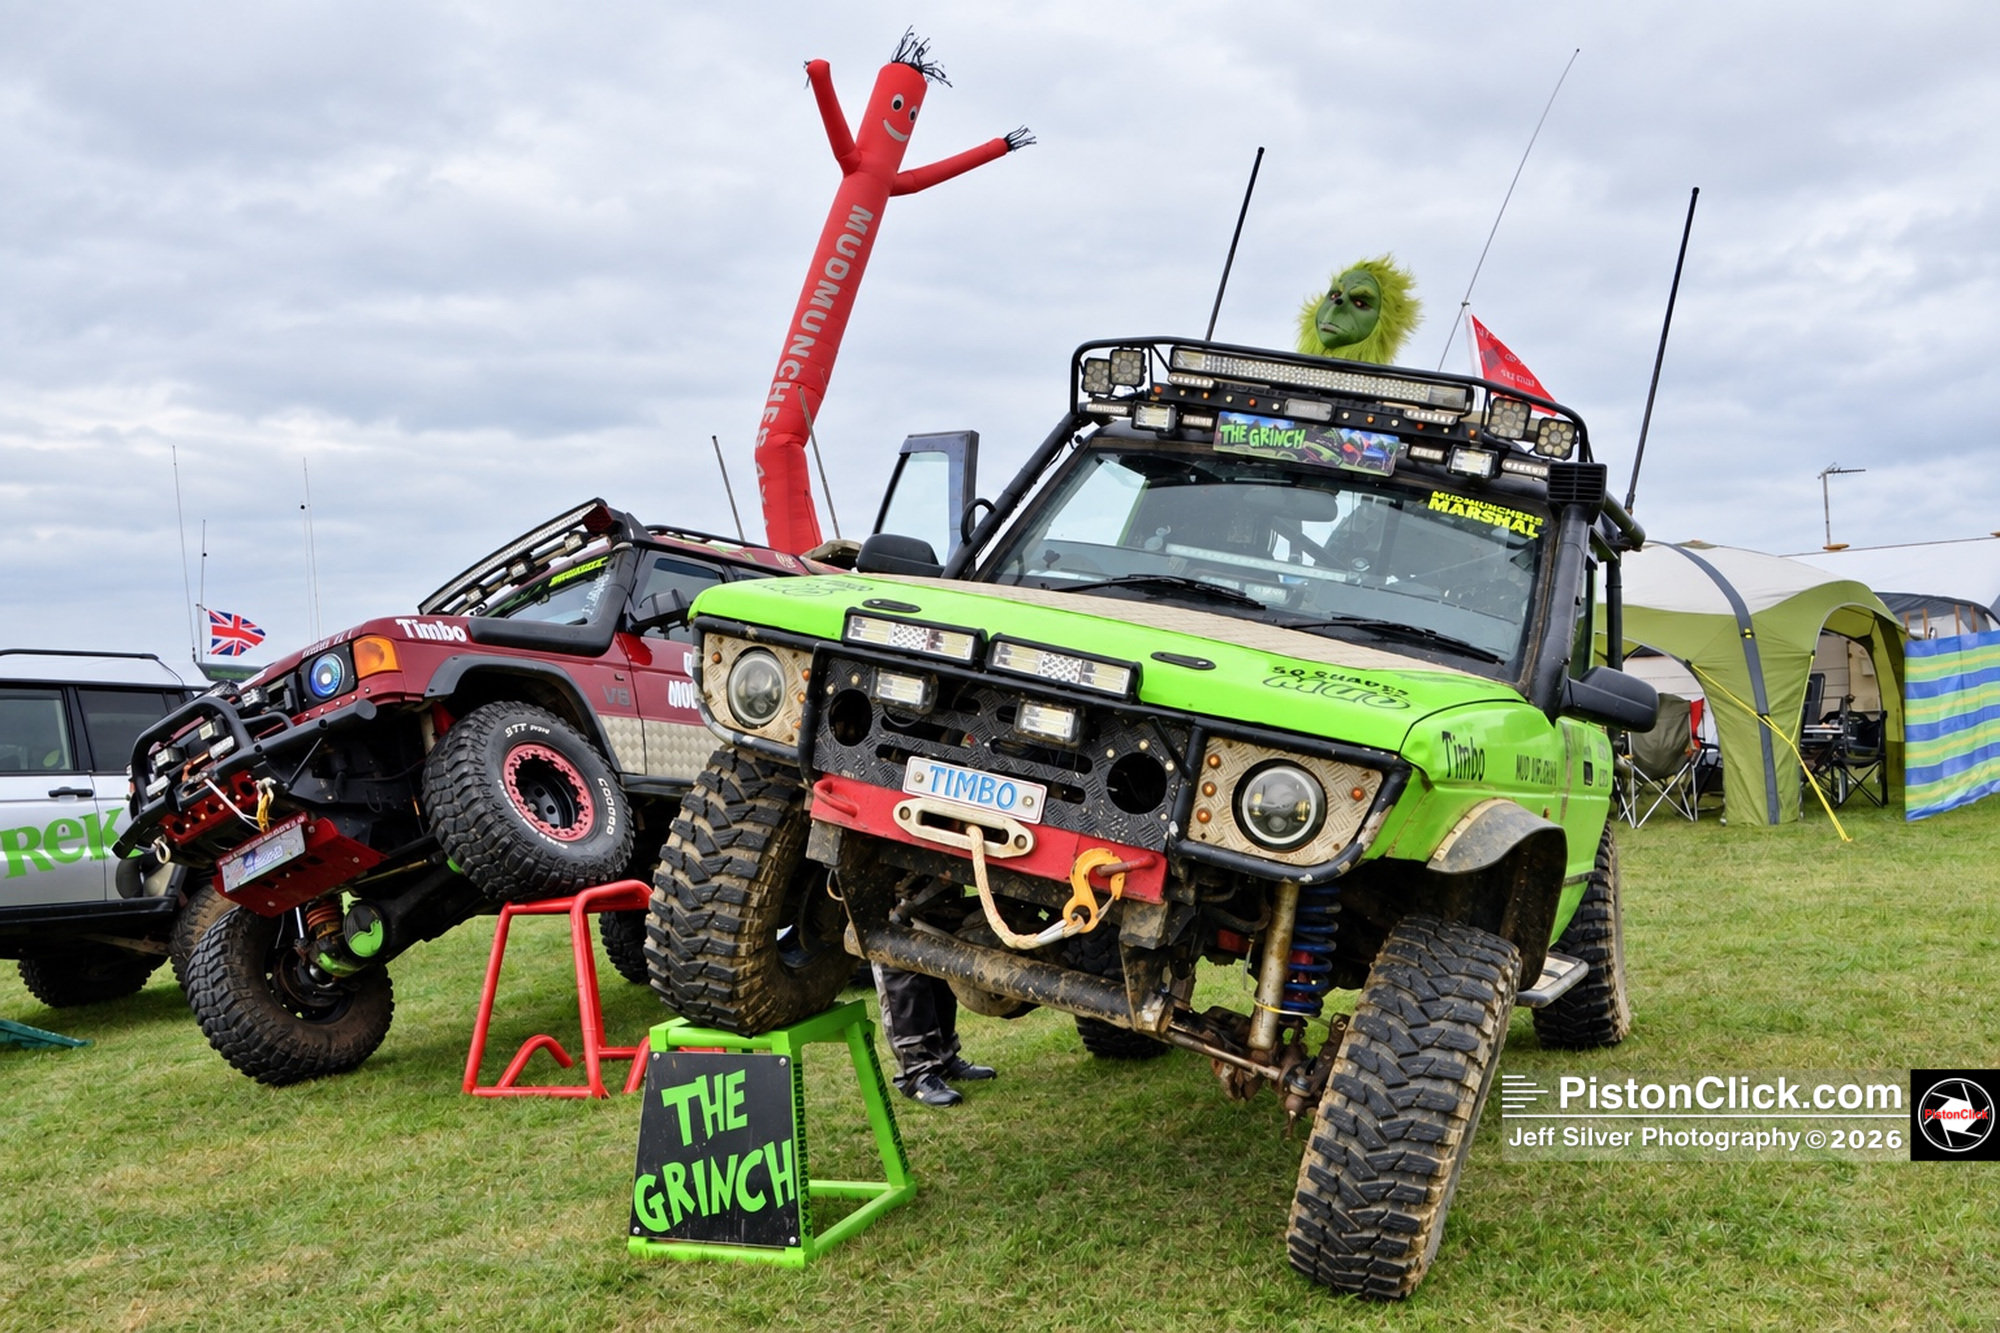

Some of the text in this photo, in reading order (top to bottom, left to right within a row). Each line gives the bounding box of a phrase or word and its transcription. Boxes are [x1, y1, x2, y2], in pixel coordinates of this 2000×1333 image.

[1220, 423, 1306, 450] THE GRINCH
[1428, 497, 1539, 538] MARSHAL
[1431, 490, 1544, 526] MUDMUNCHERS
[395, 618, 468, 643] Timbo
[505, 723, 527, 737] STT
[1442, 730, 1486, 782] Timbo
[929, 765, 1017, 810] TIMBO
[660, 1069, 748, 1147] THE
[634, 1138, 796, 1233] GRINCH
